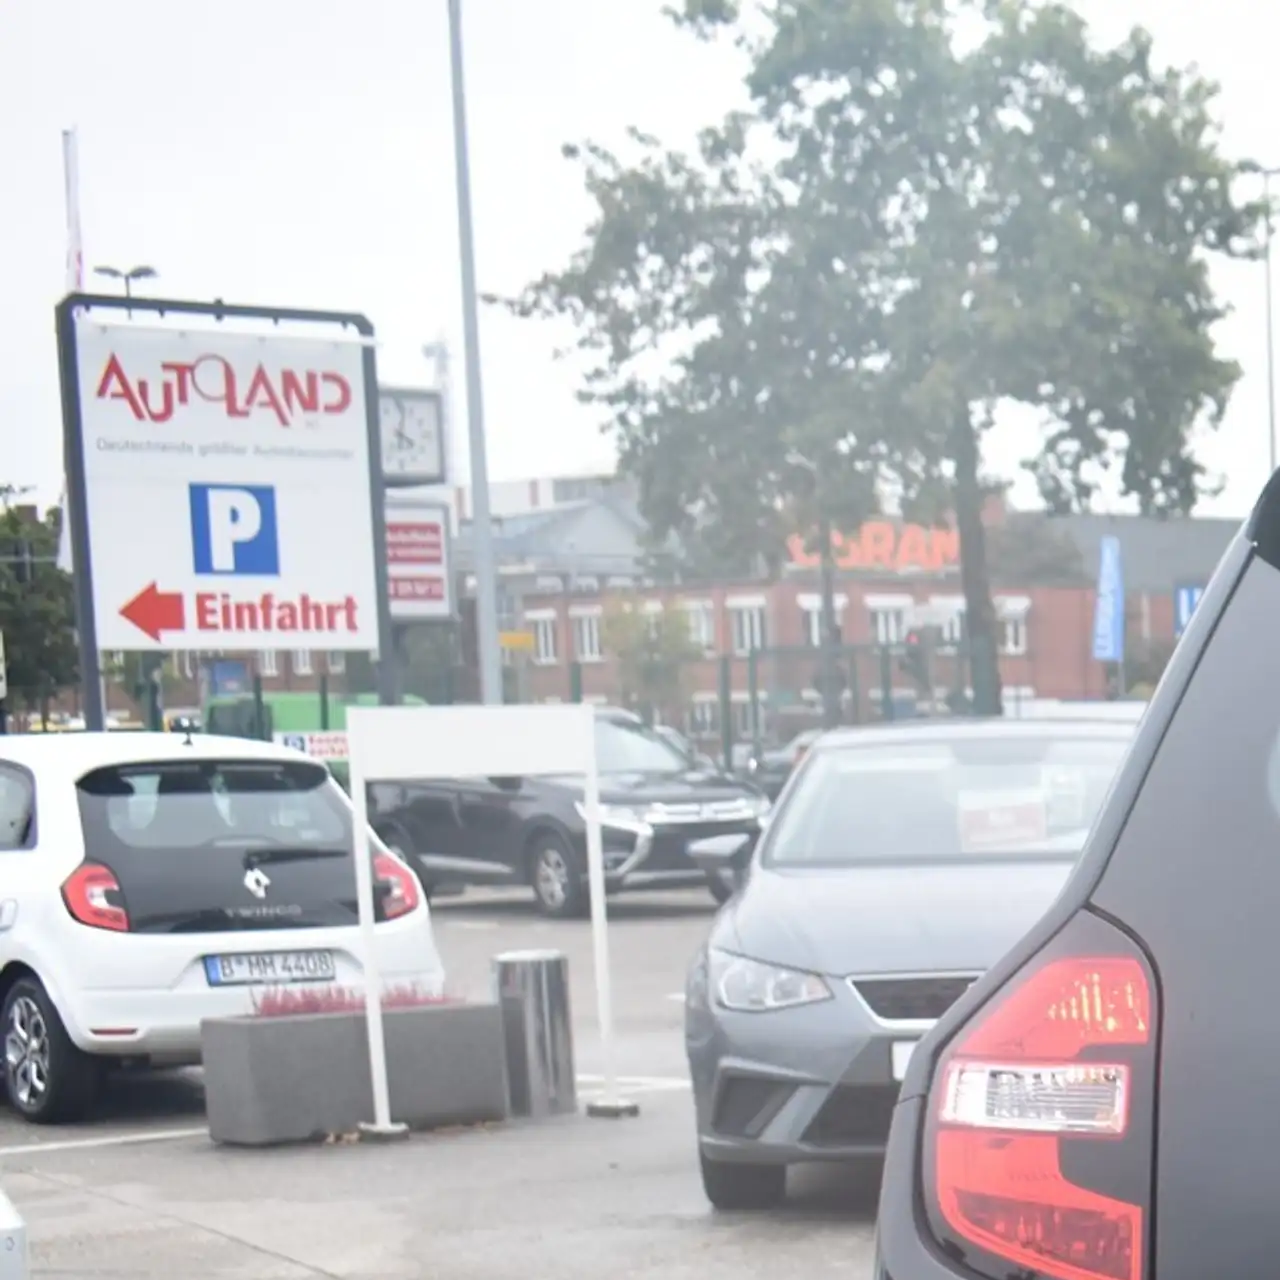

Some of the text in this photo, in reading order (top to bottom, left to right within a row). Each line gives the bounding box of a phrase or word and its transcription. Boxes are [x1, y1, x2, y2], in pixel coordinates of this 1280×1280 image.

[97, 352, 352, 427] AUTOLAND
[206, 487, 262, 571] P
[196, 592, 359, 634] Einfahrt
[221, 956, 235, 979] B
